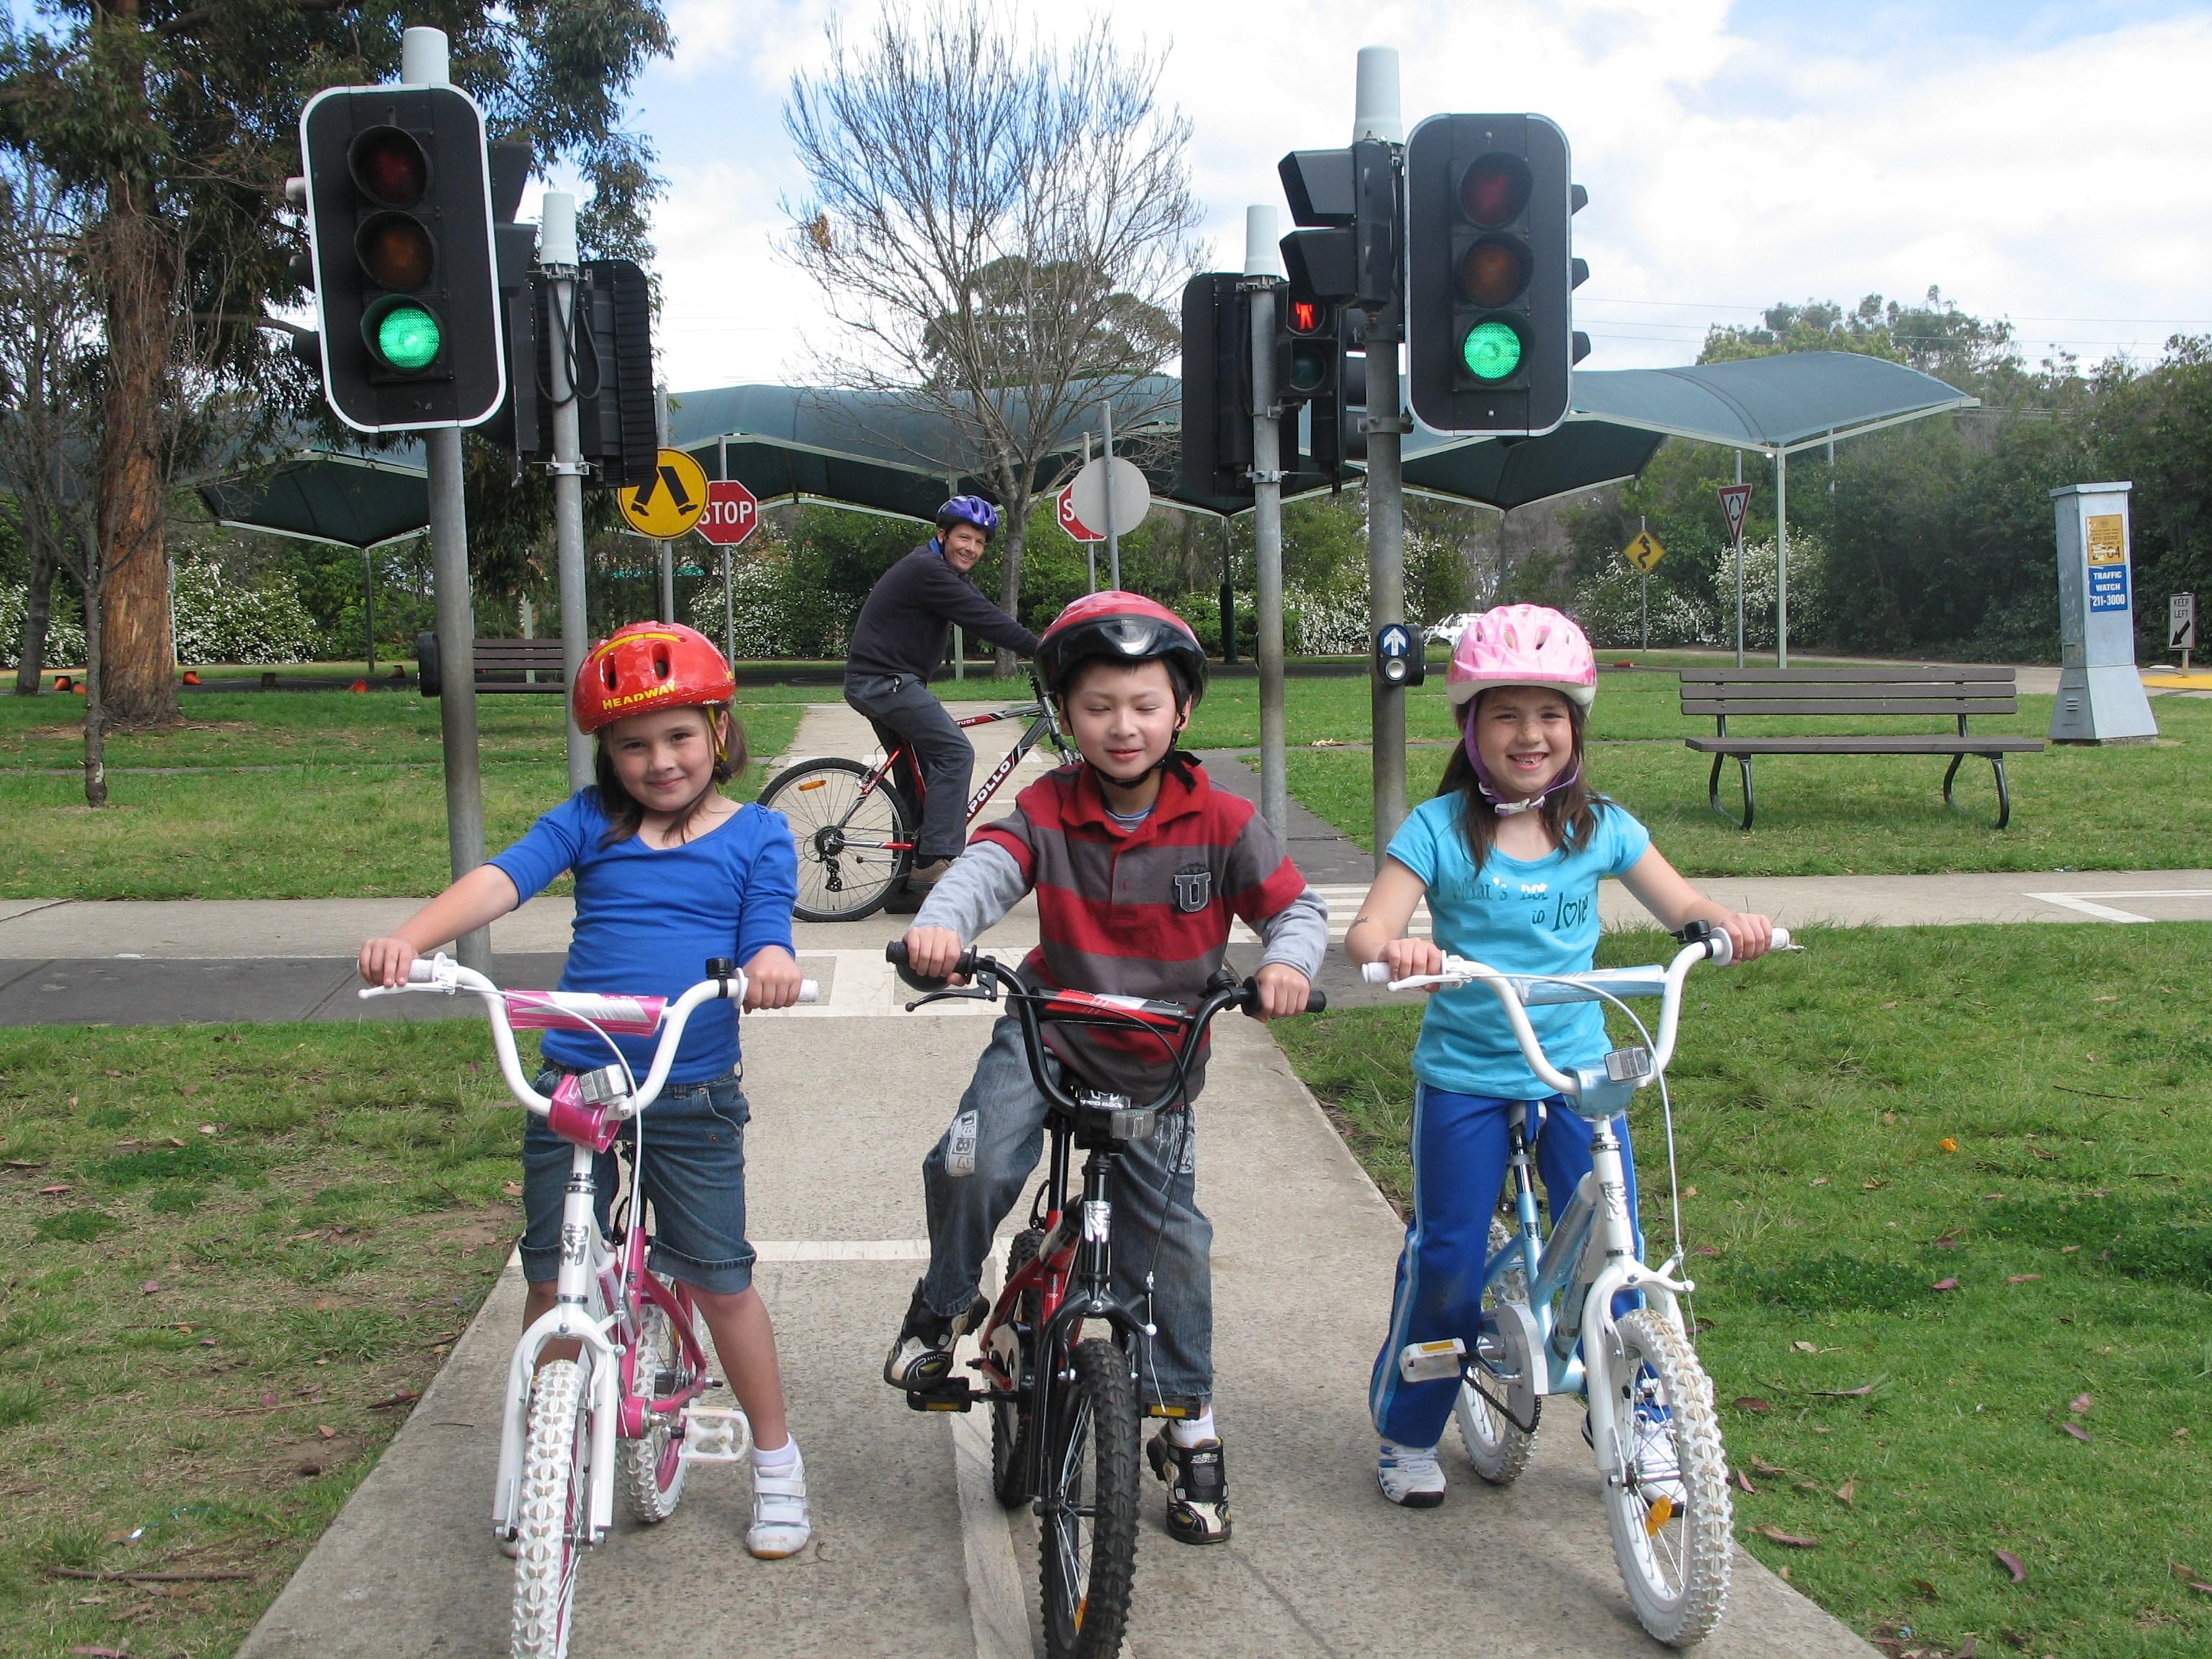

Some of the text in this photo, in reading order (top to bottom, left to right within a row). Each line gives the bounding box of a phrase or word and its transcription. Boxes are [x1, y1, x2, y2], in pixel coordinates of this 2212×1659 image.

[2093, 571, 2122, 580] TRAFFIC
[2095, 583, 2121, 592] WATCH
[2092, 594, 2125, 606] 211-3000
[2175, 609, 2188, 618] LEFT
[602, 680, 677, 710] HEADWAY
